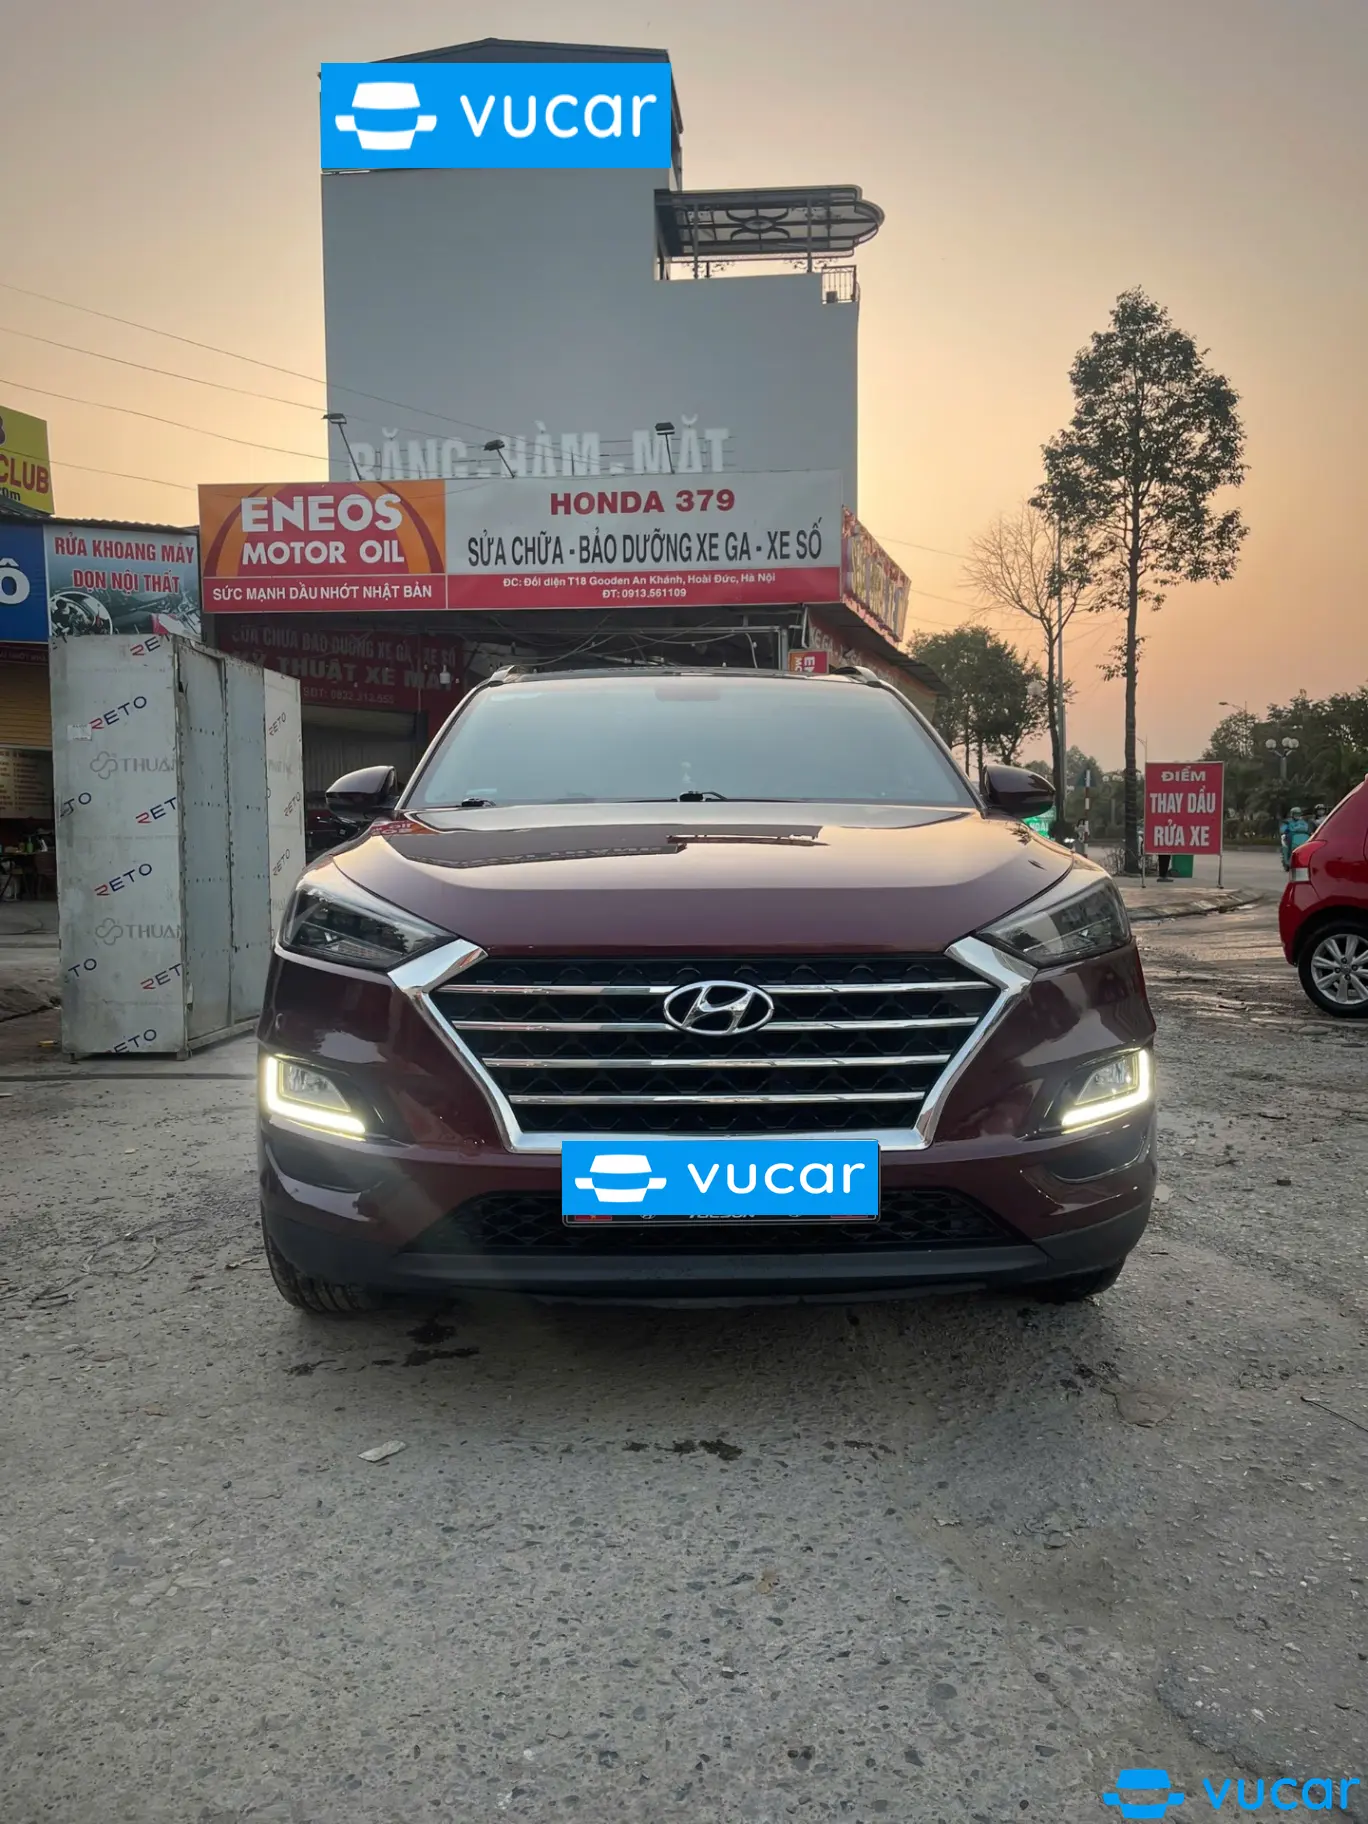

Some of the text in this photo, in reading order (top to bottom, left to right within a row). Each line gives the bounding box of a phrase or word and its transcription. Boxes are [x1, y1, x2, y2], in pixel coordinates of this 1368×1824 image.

[0, 454, 49, 494] CLUB
[241, 493, 403, 533] ENEOS
[550, 489, 735, 516] HONDA 379
[55, 532, 194, 563] RỬA KHOANG MÁY
[242, 540, 405, 565] MOTOR OIL
[468, 529, 507, 566] SỬA
[511, 531, 564, 565] CHỮA
[579, 527, 617, 564] BẢO
[623, 528, 692, 563] DƯỠNG
[696, 532, 719, 562] XE
[725, 532, 751, 561] GA
[767, 530, 790, 560] XE
[796, 517, 822, 560] SỐ
[73, 569, 179, 594] DỌN NỘI THẤT
[213, 581, 432, 602] SỨC MẠNH DẦU NHỚT NHẬT BẢN
[568, 576, 587, 586] T18
[632, 575, 647, 585] An
[741, 573, 755, 583] Hà
[622, 588, 687, 598] 0913.561109
[366, 665, 396, 686] XE
[1149, 792, 1183, 814] THAY
[1154, 819, 1210, 847] RỬA XE
[104, 1029, 157, 1054] ETO
